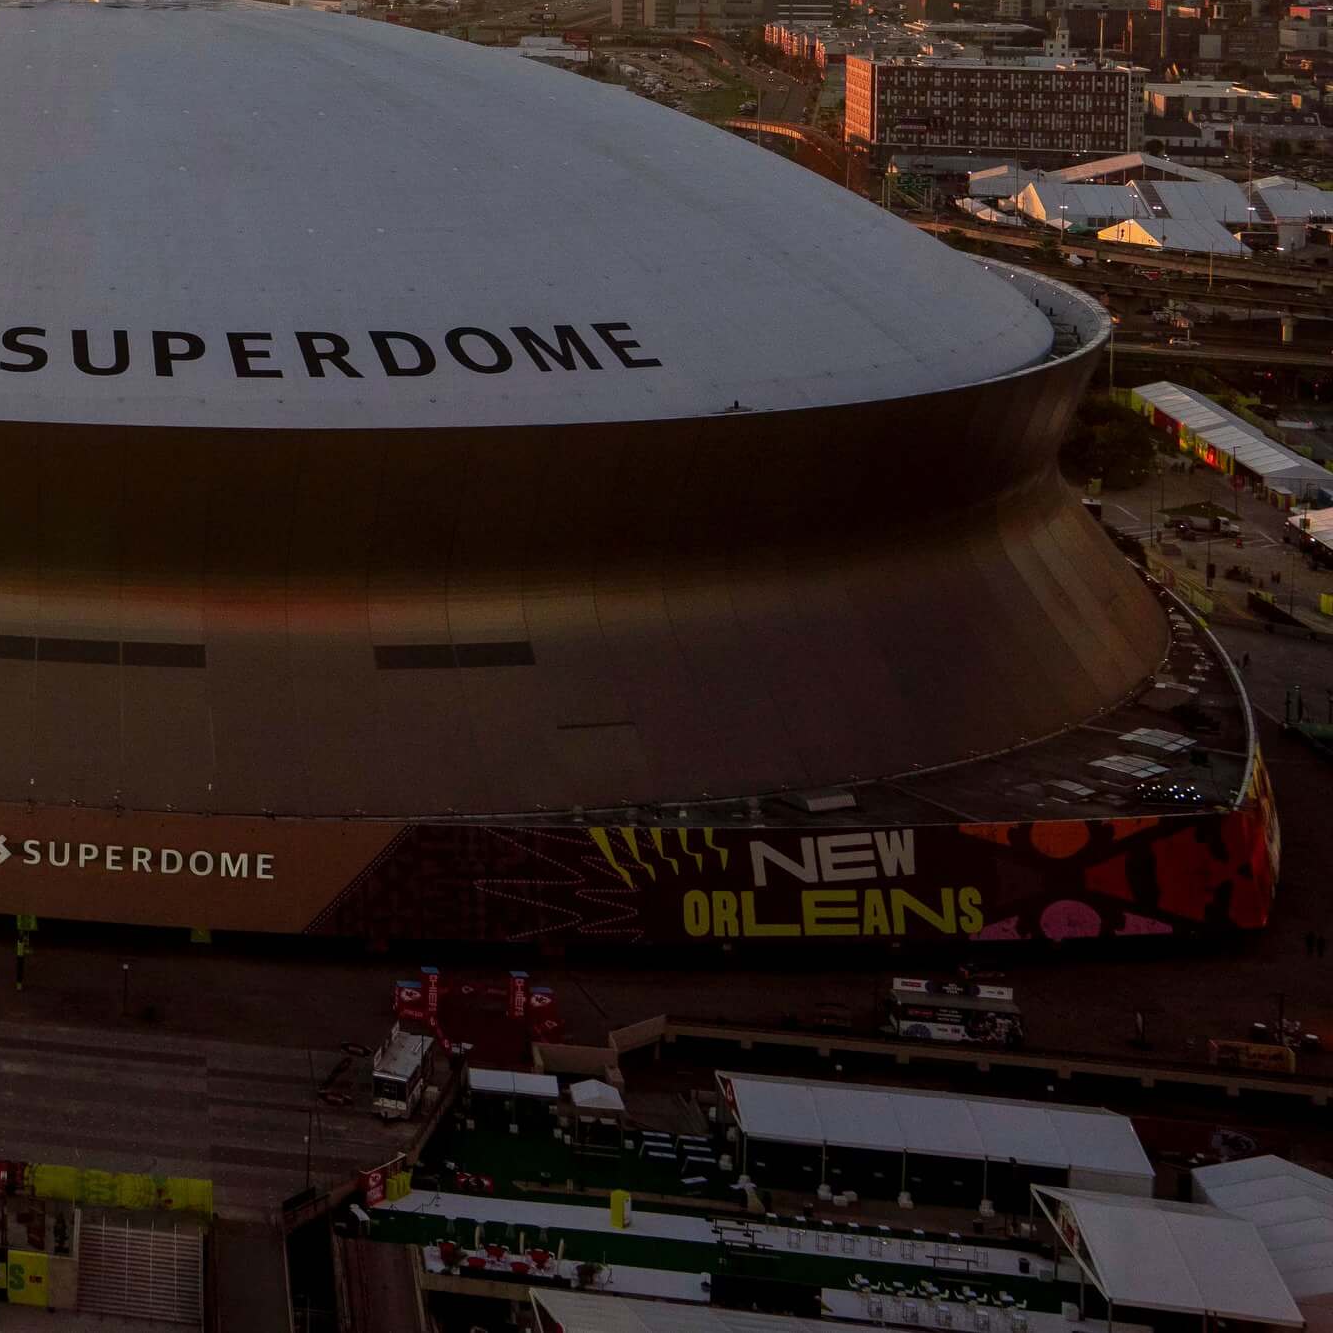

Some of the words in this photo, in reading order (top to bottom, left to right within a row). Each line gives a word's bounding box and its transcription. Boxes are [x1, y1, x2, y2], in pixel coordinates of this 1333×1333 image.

[23, 839, 276, 881] SUPERDOME
[749, 829, 916, 887] NEW
[684, 888, 983, 937] ORLEANS
